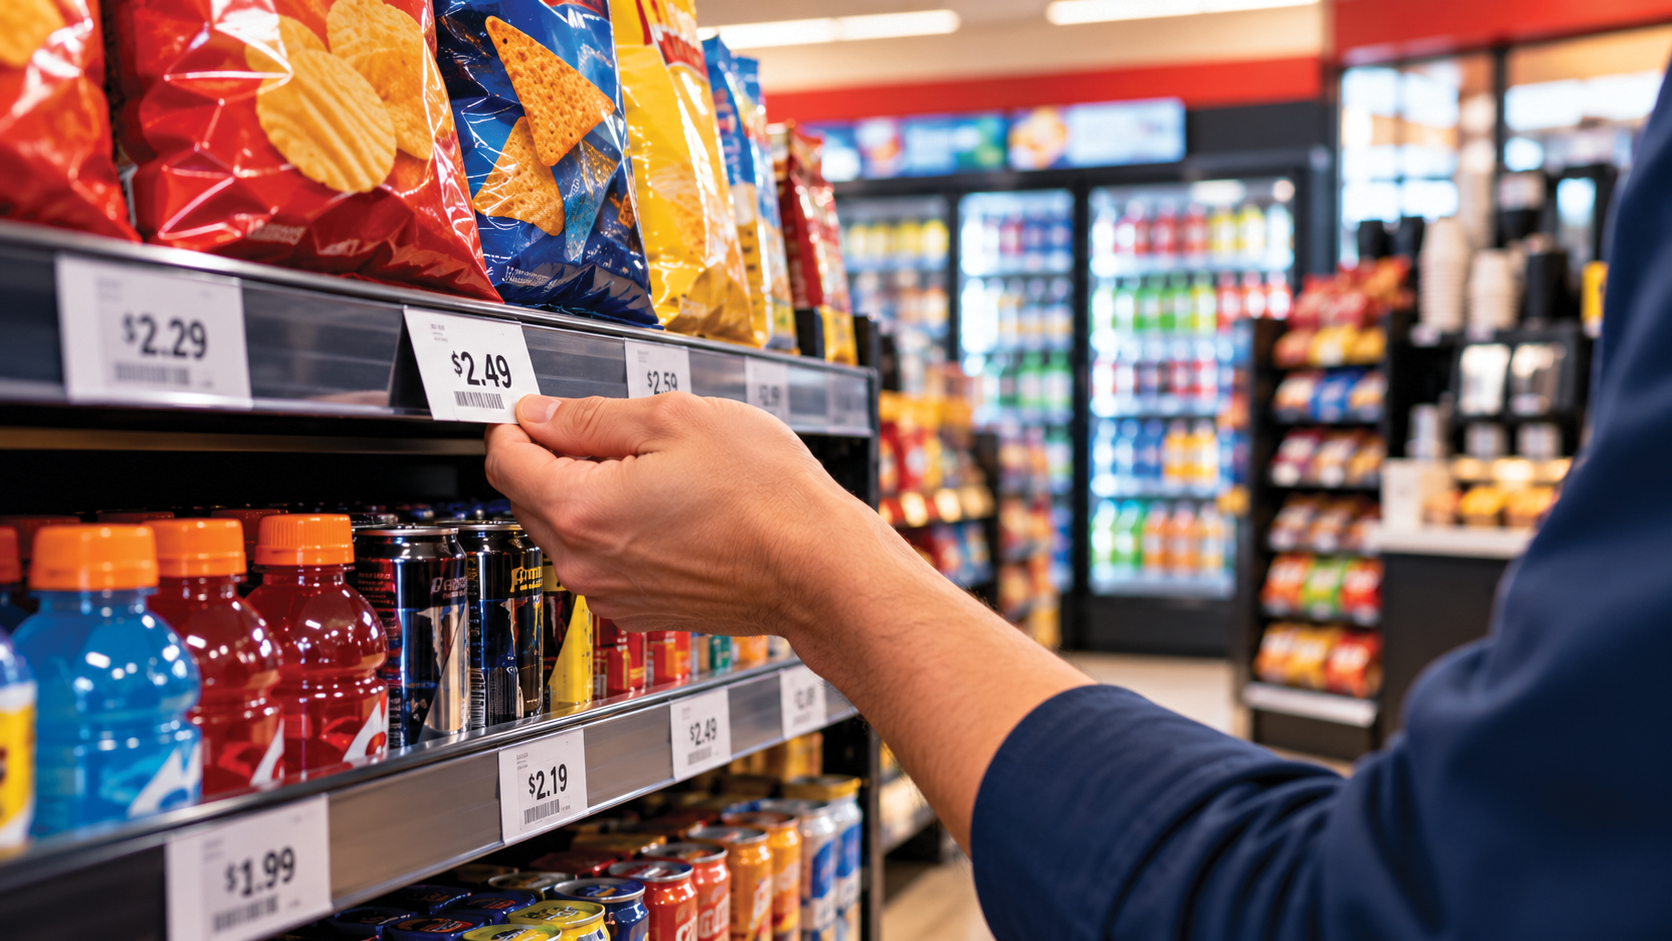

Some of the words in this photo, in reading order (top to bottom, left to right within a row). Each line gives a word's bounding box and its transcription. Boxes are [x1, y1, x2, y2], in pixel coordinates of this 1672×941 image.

[123, 312, 207, 360] $2.29
[451, 350, 512, 389] $2.49
[647, 369, 678, 395] $2.59
[690, 717, 717, 747] $2.49
[528, 763, 568, 801] $2.19
[225, 846, 296, 897] $1.99
